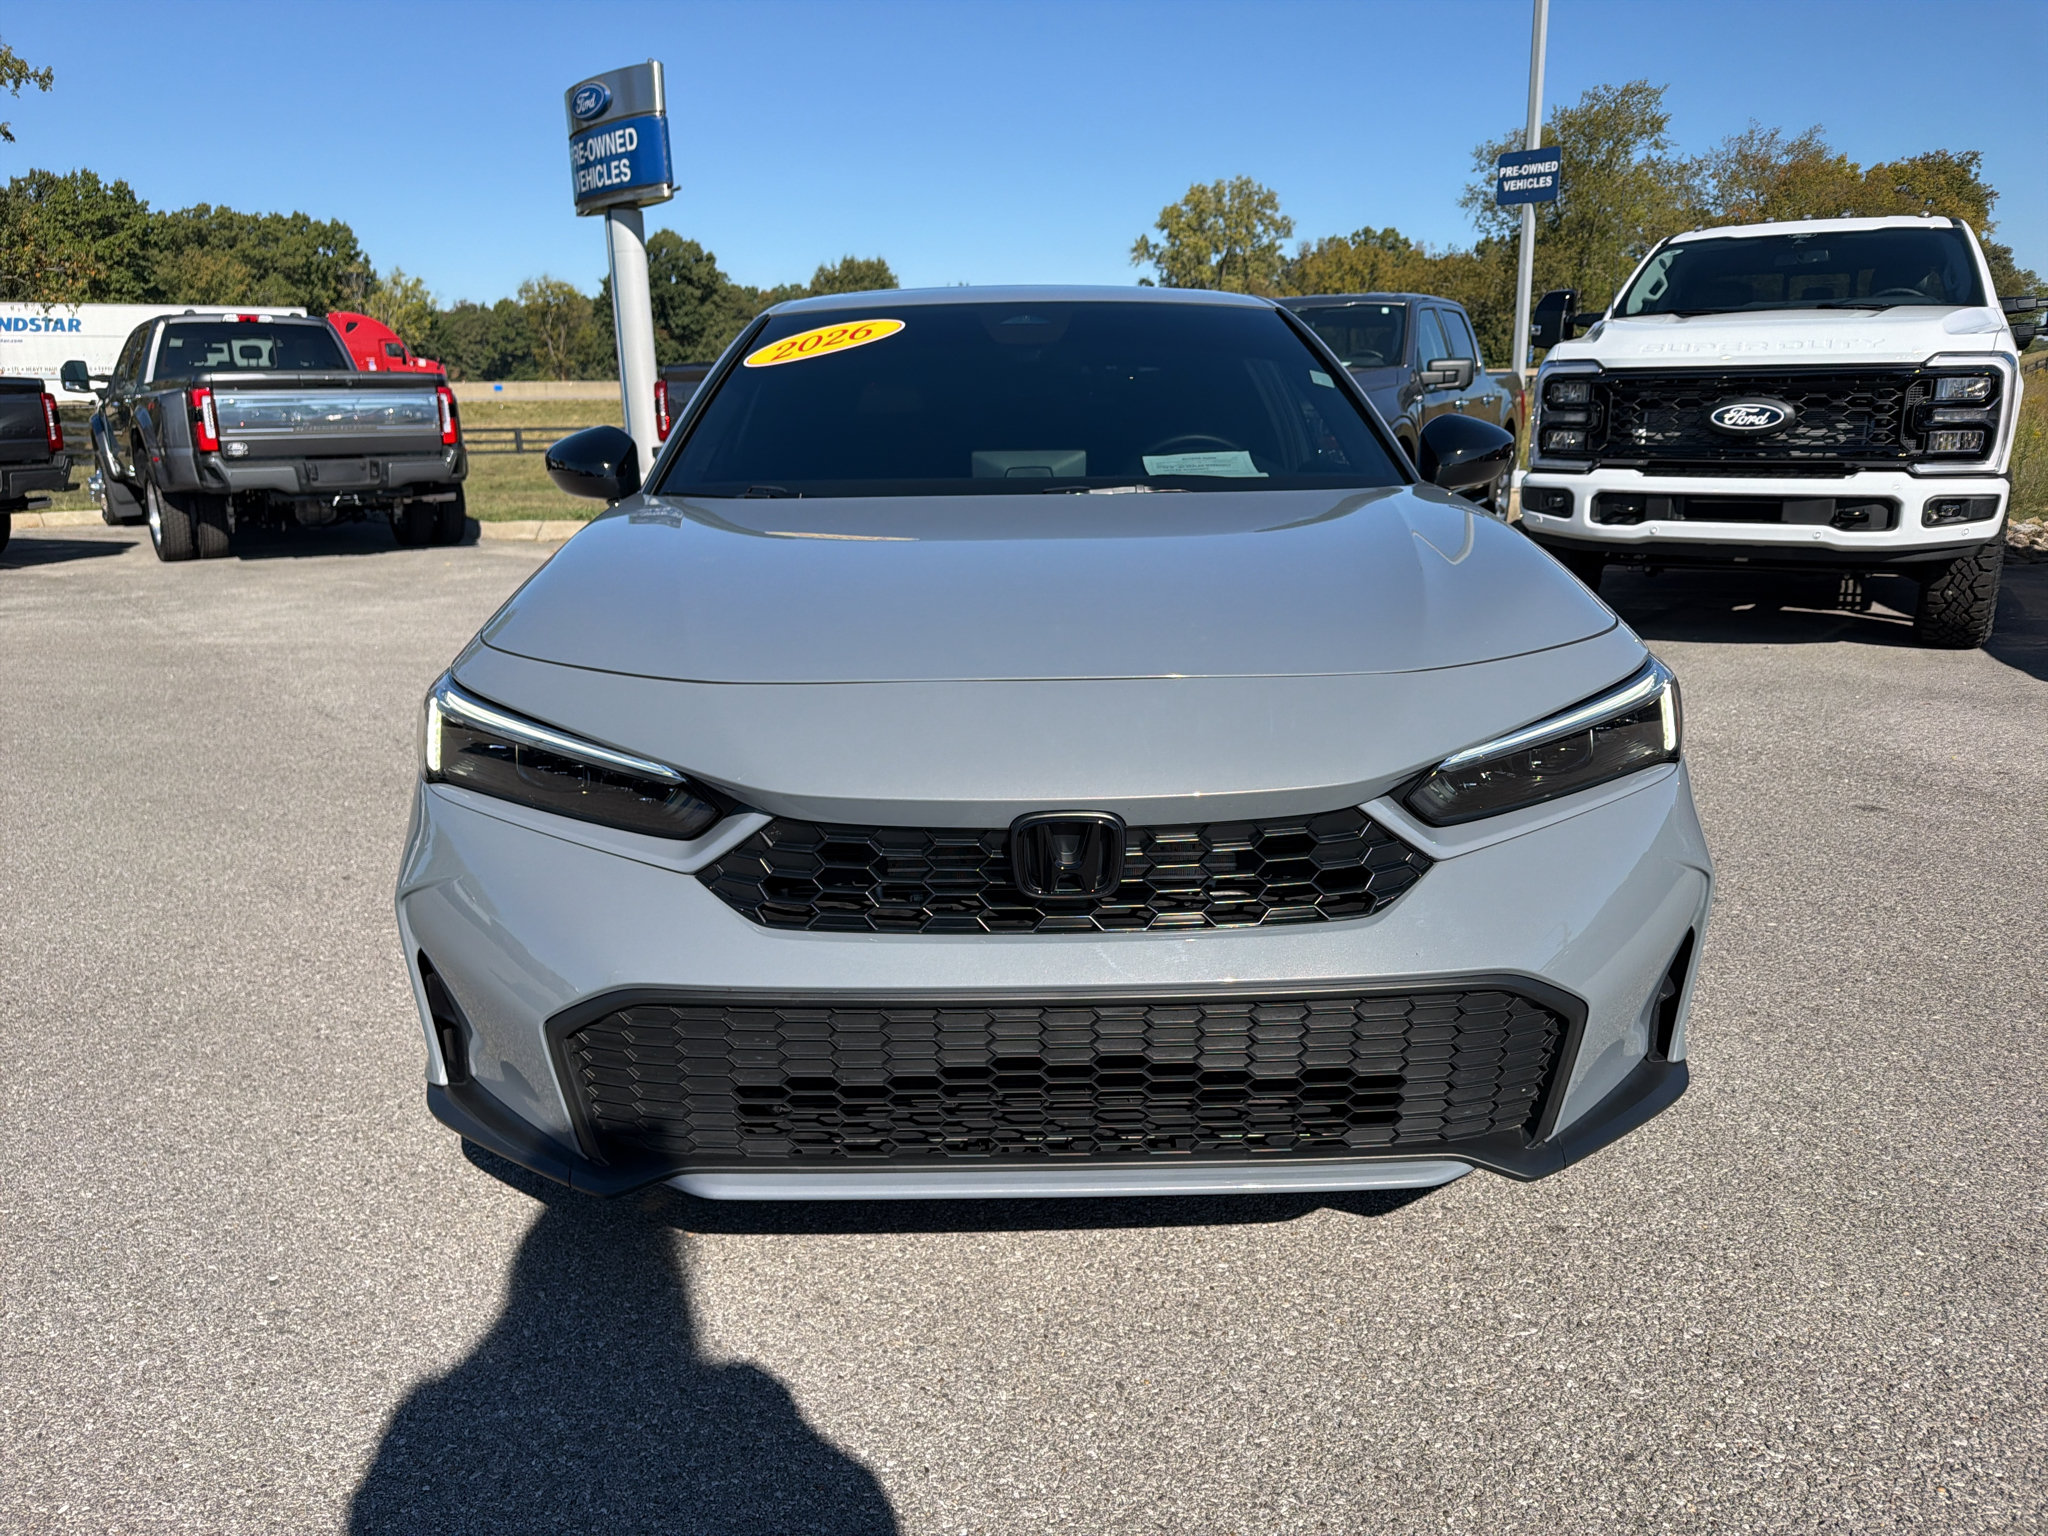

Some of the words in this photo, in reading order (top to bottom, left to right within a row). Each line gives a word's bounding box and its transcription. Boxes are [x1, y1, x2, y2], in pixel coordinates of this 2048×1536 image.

[575, 91, 597, 114] Ford
[1499, 161, 1559, 178] PRE-OWNED
[1503, 176, 1553, 192] VEHICLES
[770, 322, 878, 362] 2026
[1723, 407, 1771, 426] Ford
